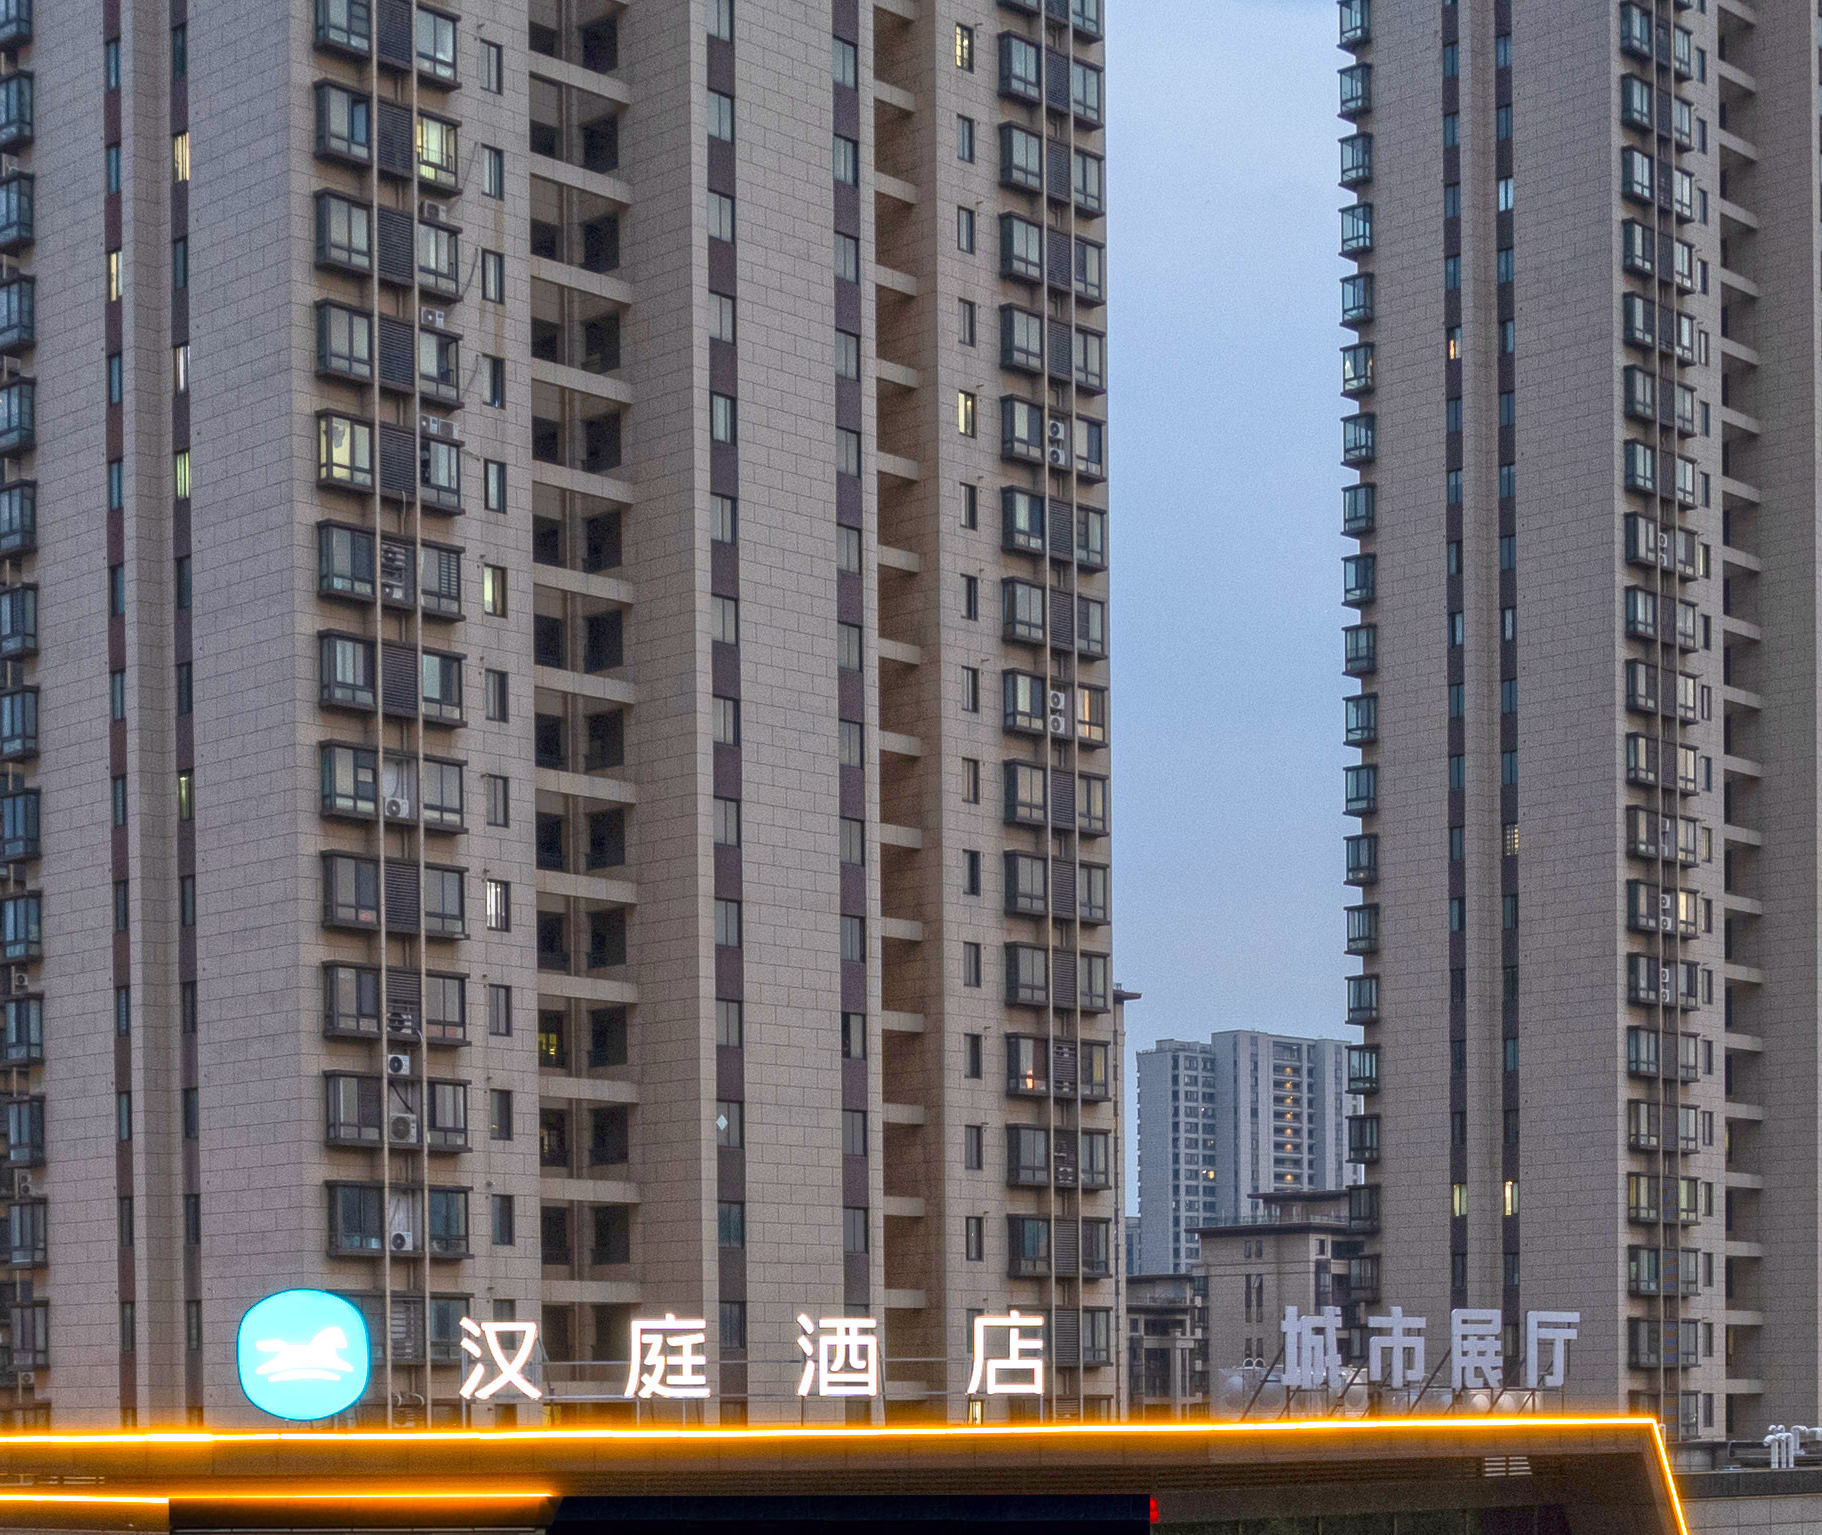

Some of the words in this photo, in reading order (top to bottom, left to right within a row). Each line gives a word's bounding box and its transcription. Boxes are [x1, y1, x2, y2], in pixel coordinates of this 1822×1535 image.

[458, 1309, 1045, 1399] 汉庭酒店
[1280, 1305, 1581, 1390] 城市展厅
